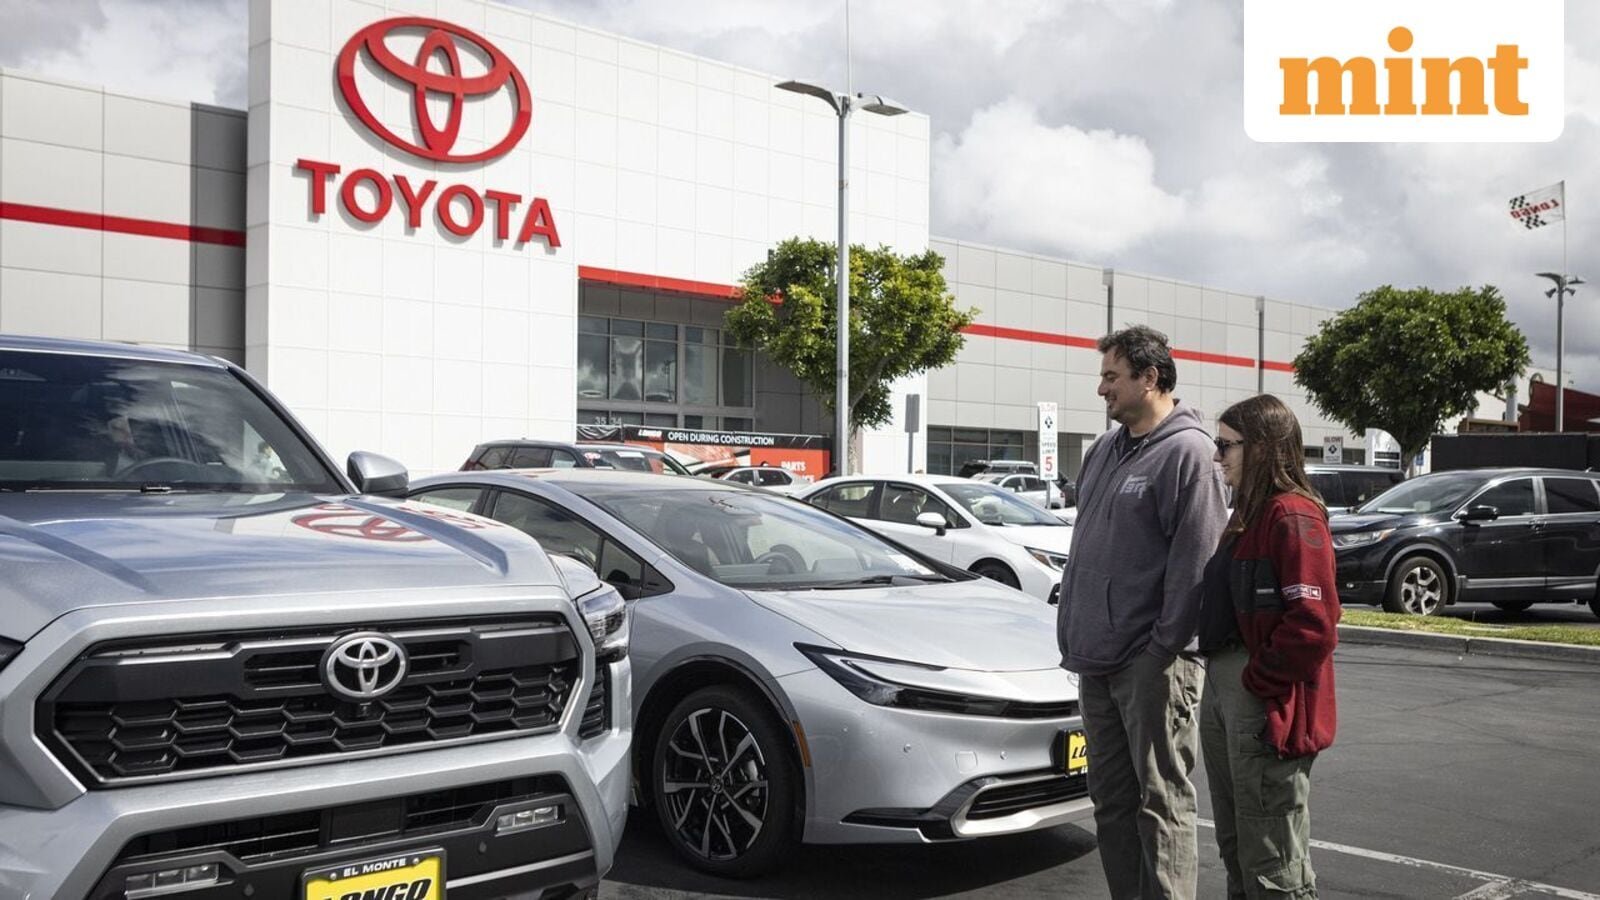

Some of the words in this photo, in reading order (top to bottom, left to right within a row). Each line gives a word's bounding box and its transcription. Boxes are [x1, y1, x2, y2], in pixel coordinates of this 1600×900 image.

[296, 158, 562, 248] TOYOTA
[668, 431, 689, 441] OPEN
[690, 433, 719, 443] DURING
[720, 435, 775, 446] CONSTRUCTION
[1045, 456, 1053, 472] 5
[343, 868, 359, 878] EL
[362, 858, 407, 873] MONTE
[322, 878, 432, 900] NGO
